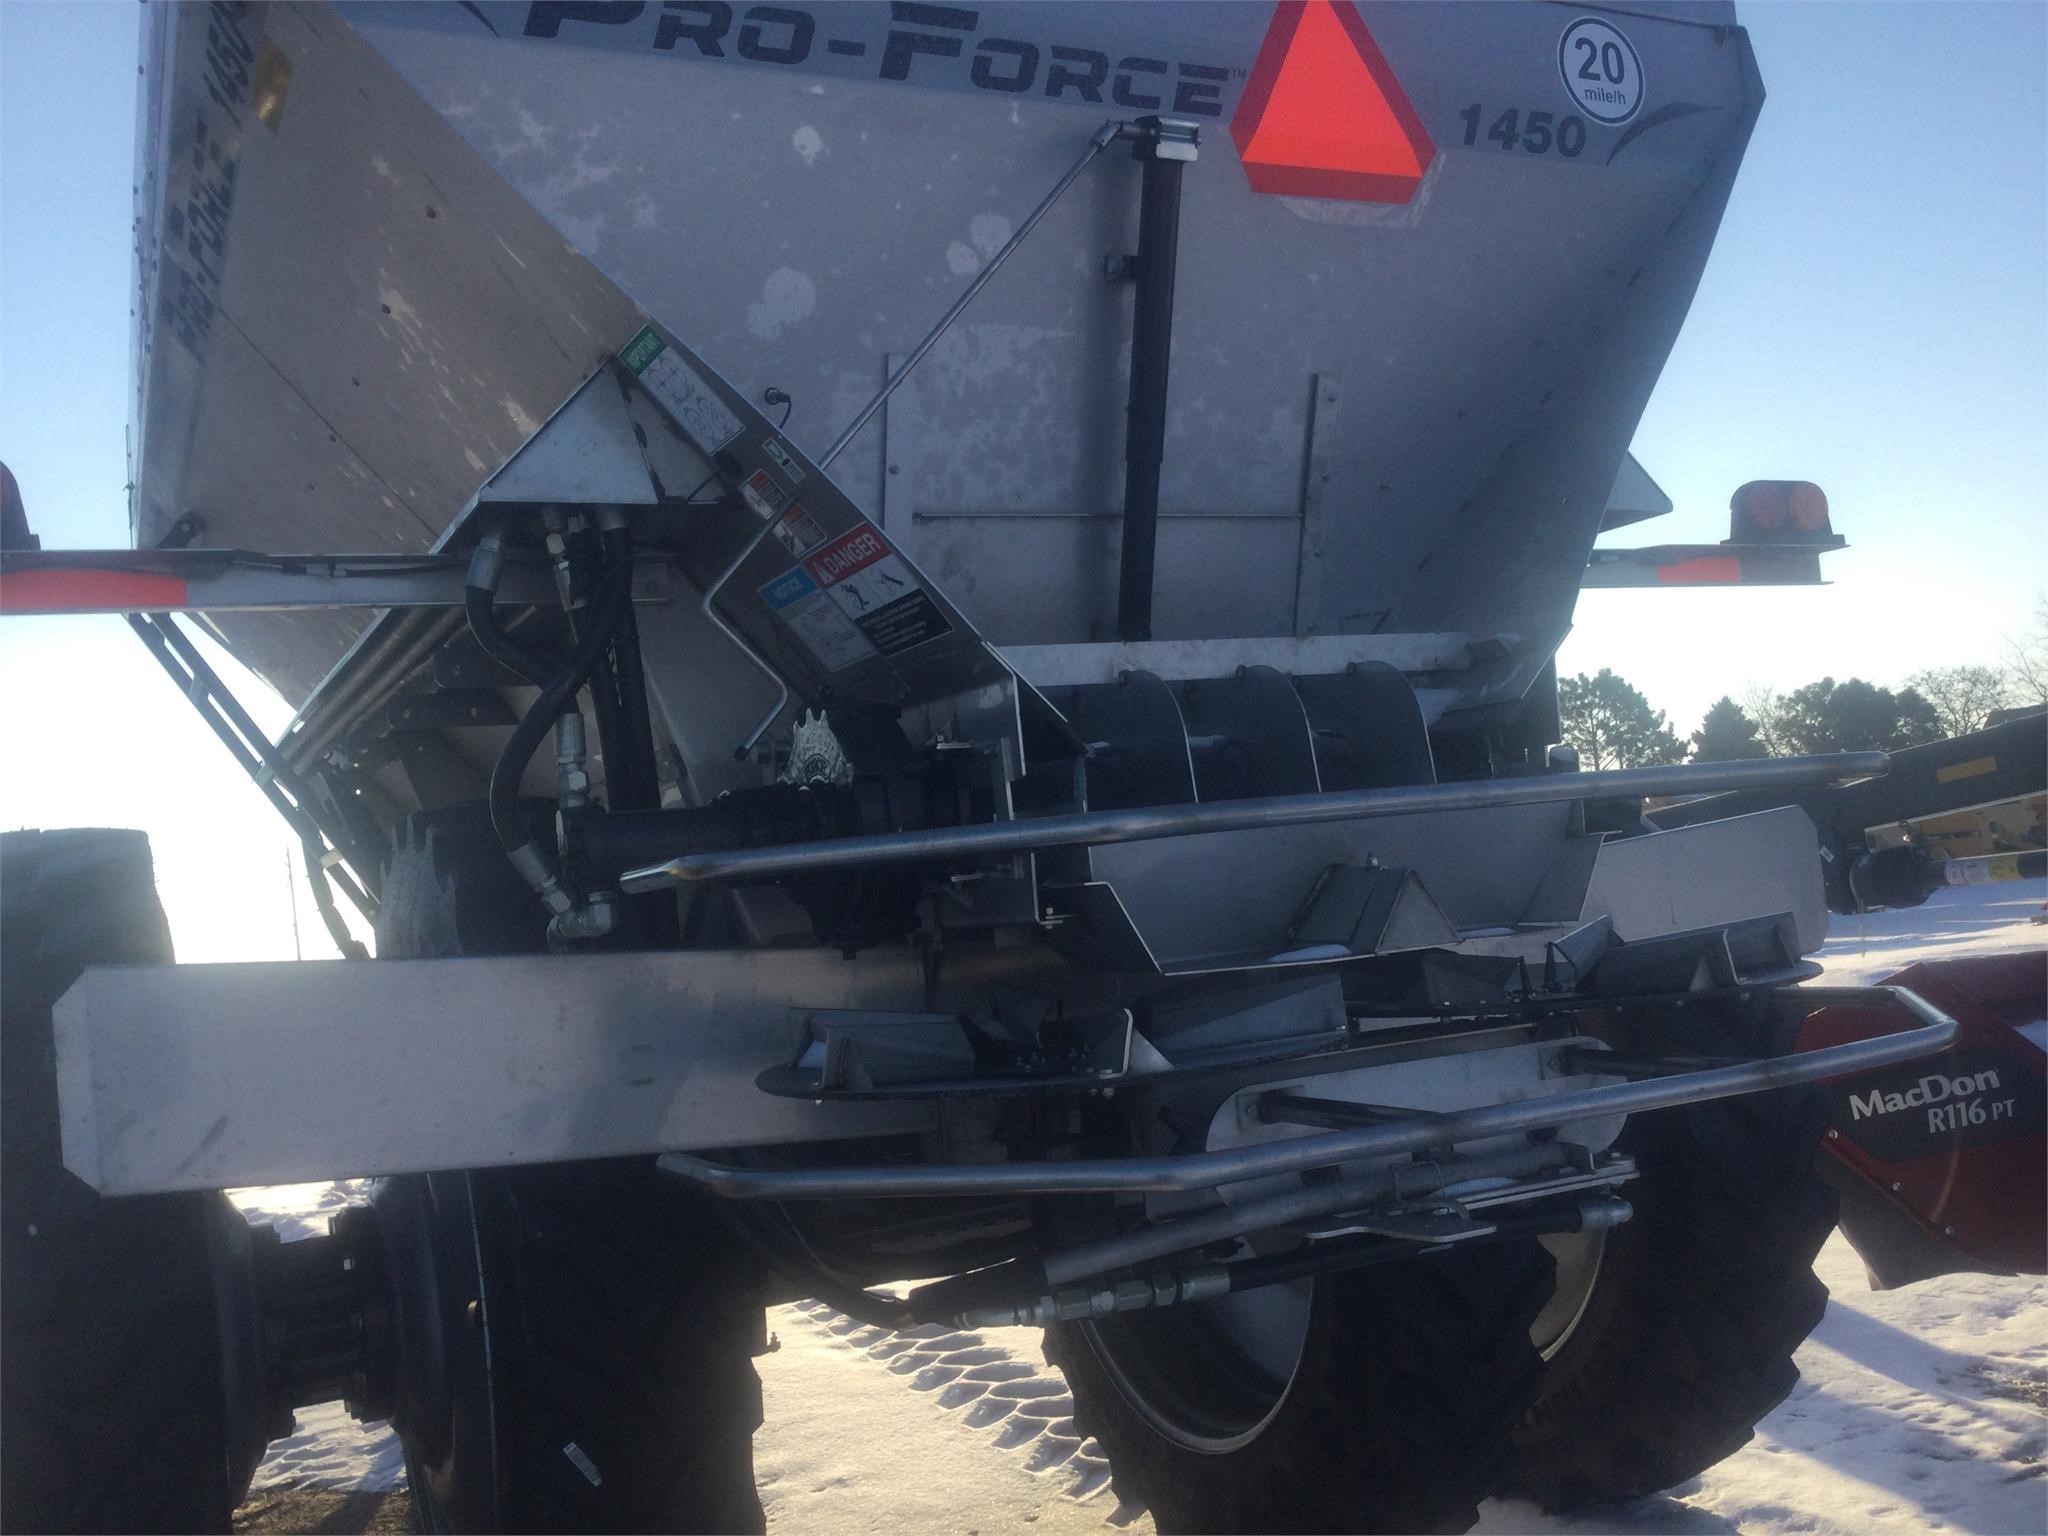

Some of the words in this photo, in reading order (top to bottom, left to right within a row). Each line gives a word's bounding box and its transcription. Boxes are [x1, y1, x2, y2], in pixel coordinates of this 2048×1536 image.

[1575, 37, 1625, 84] 20
[1584, 87, 1627, 106] mile/h
[1459, 103, 1587, 158] 1450
[826, 533, 881, 574] DANGER
[1849, 1069, 2000, 1121] MacDon
[1927, 1098, 1986, 1134] R116
[1991, 1099, 2015, 1120] PT
